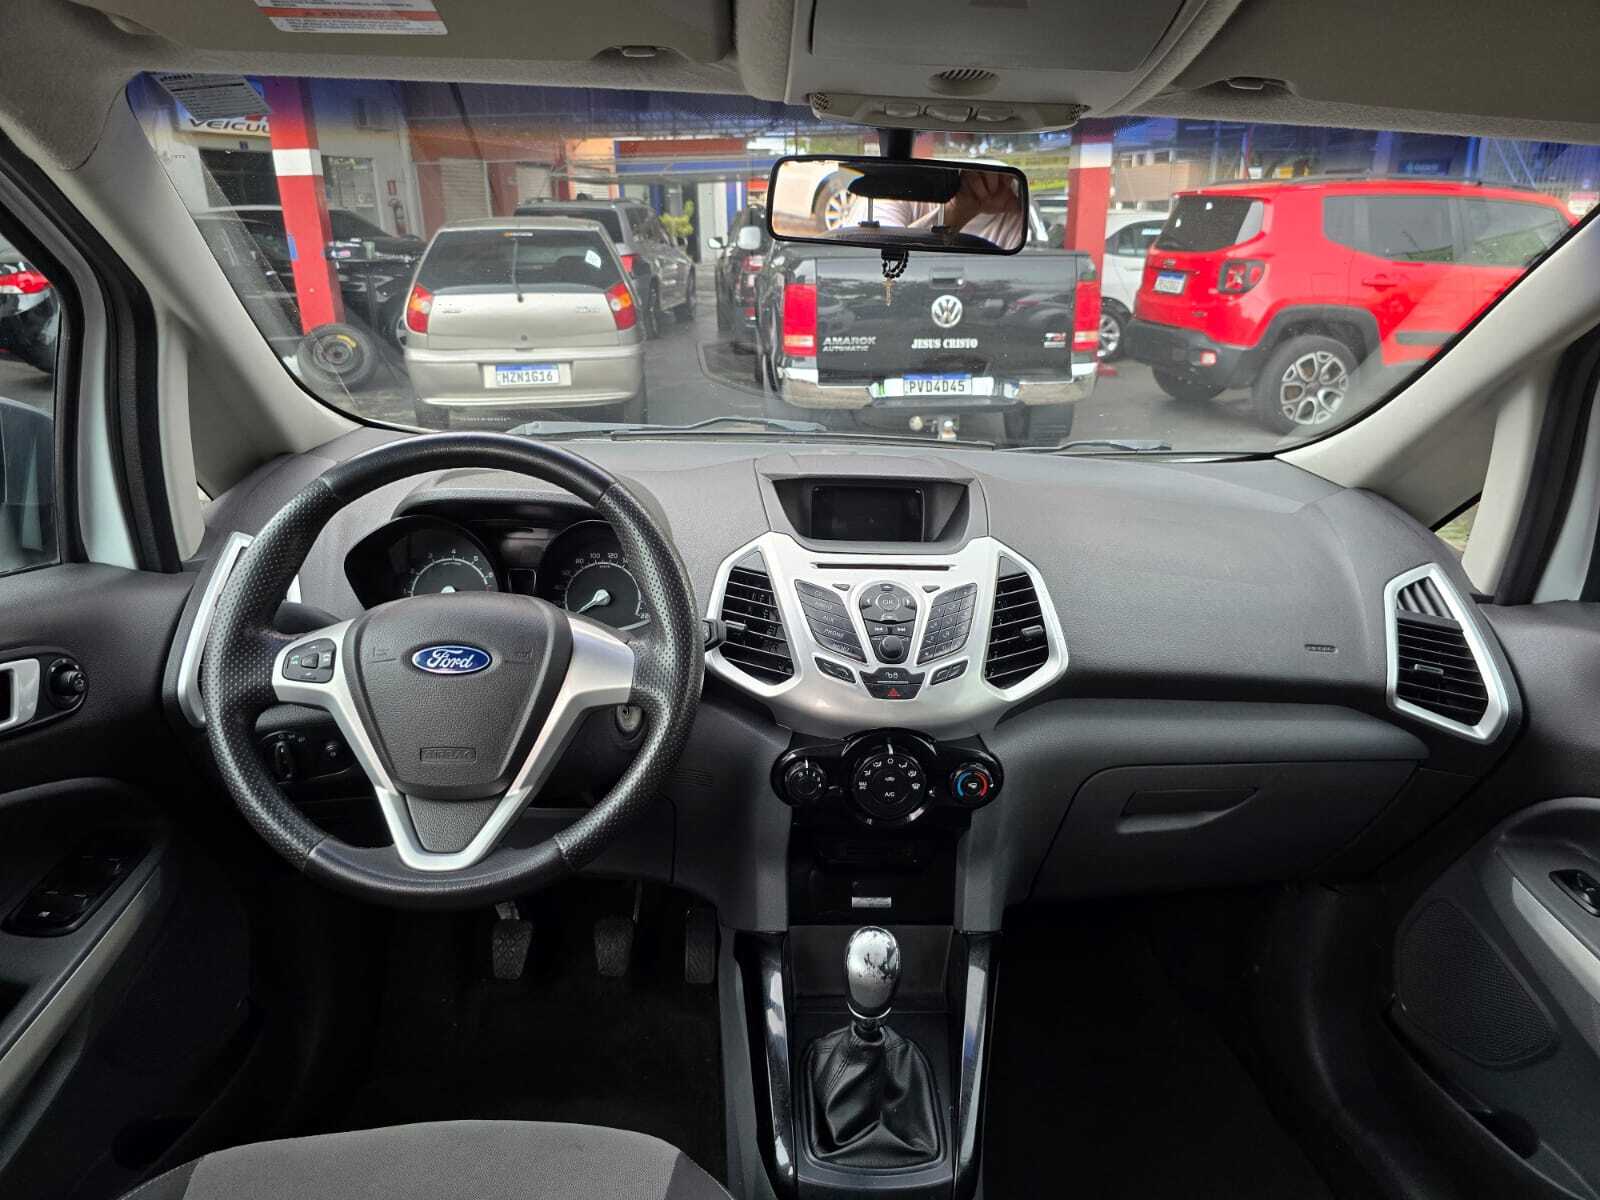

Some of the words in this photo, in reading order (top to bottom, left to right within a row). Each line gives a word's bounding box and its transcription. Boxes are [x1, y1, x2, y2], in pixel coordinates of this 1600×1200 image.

[822, 336, 877, 345] AMAROK
[911, 337, 942, 349] JESUS
[942, 337, 979, 349] CRISTO
[426, 648, 474, 668] Ford
